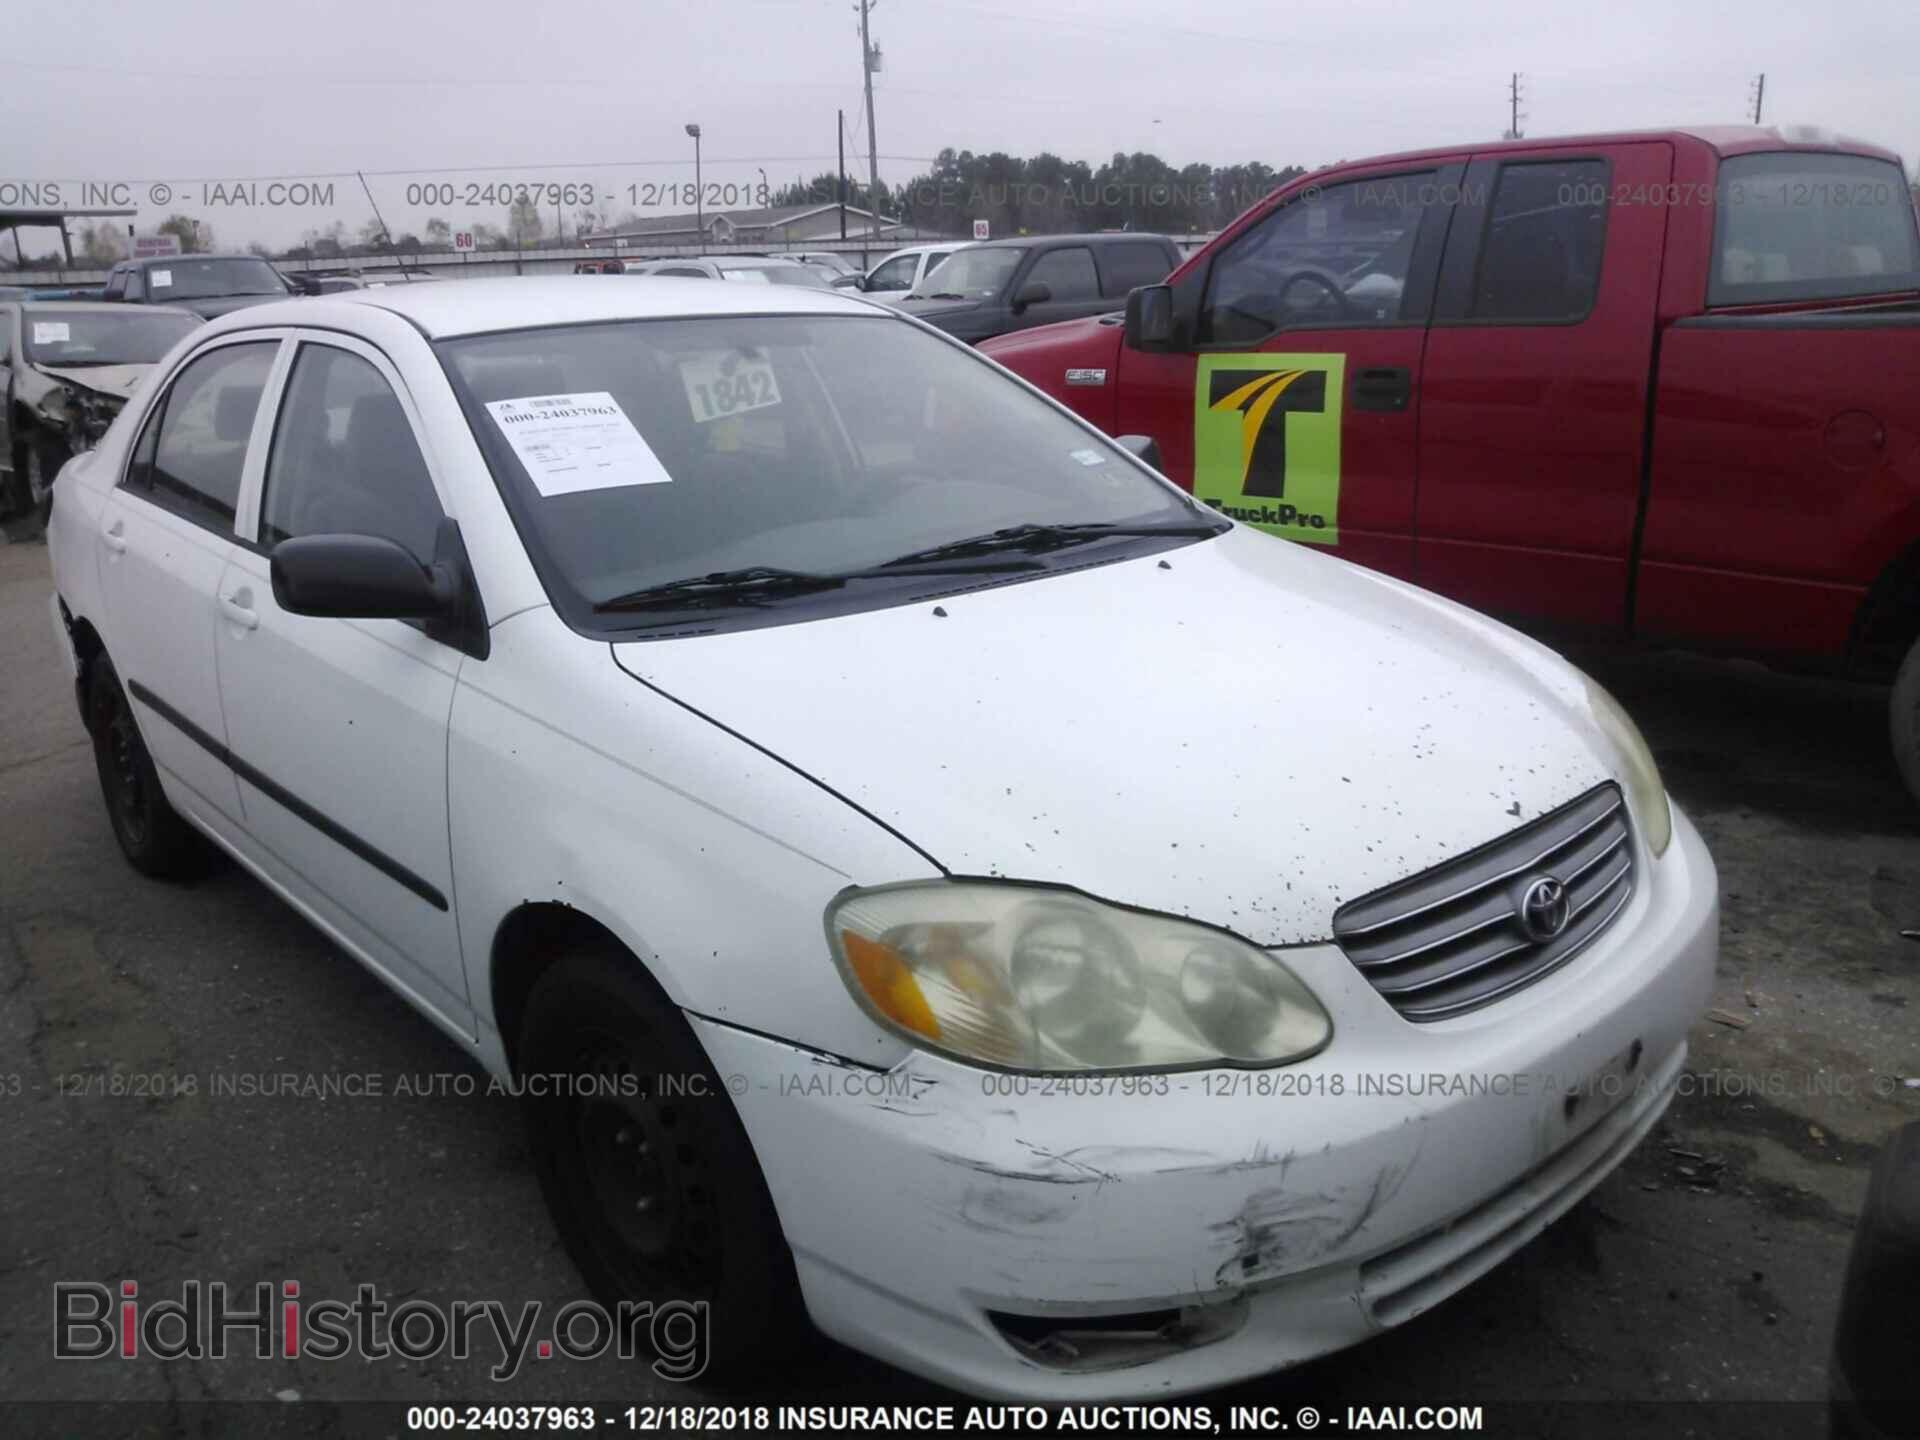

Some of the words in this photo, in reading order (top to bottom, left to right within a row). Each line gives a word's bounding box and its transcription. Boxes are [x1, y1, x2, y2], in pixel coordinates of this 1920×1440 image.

[455, 232, 472, 248] 60
[693, 370, 779, 417] 1842
[503, 405, 617, 425] 000-24037963
